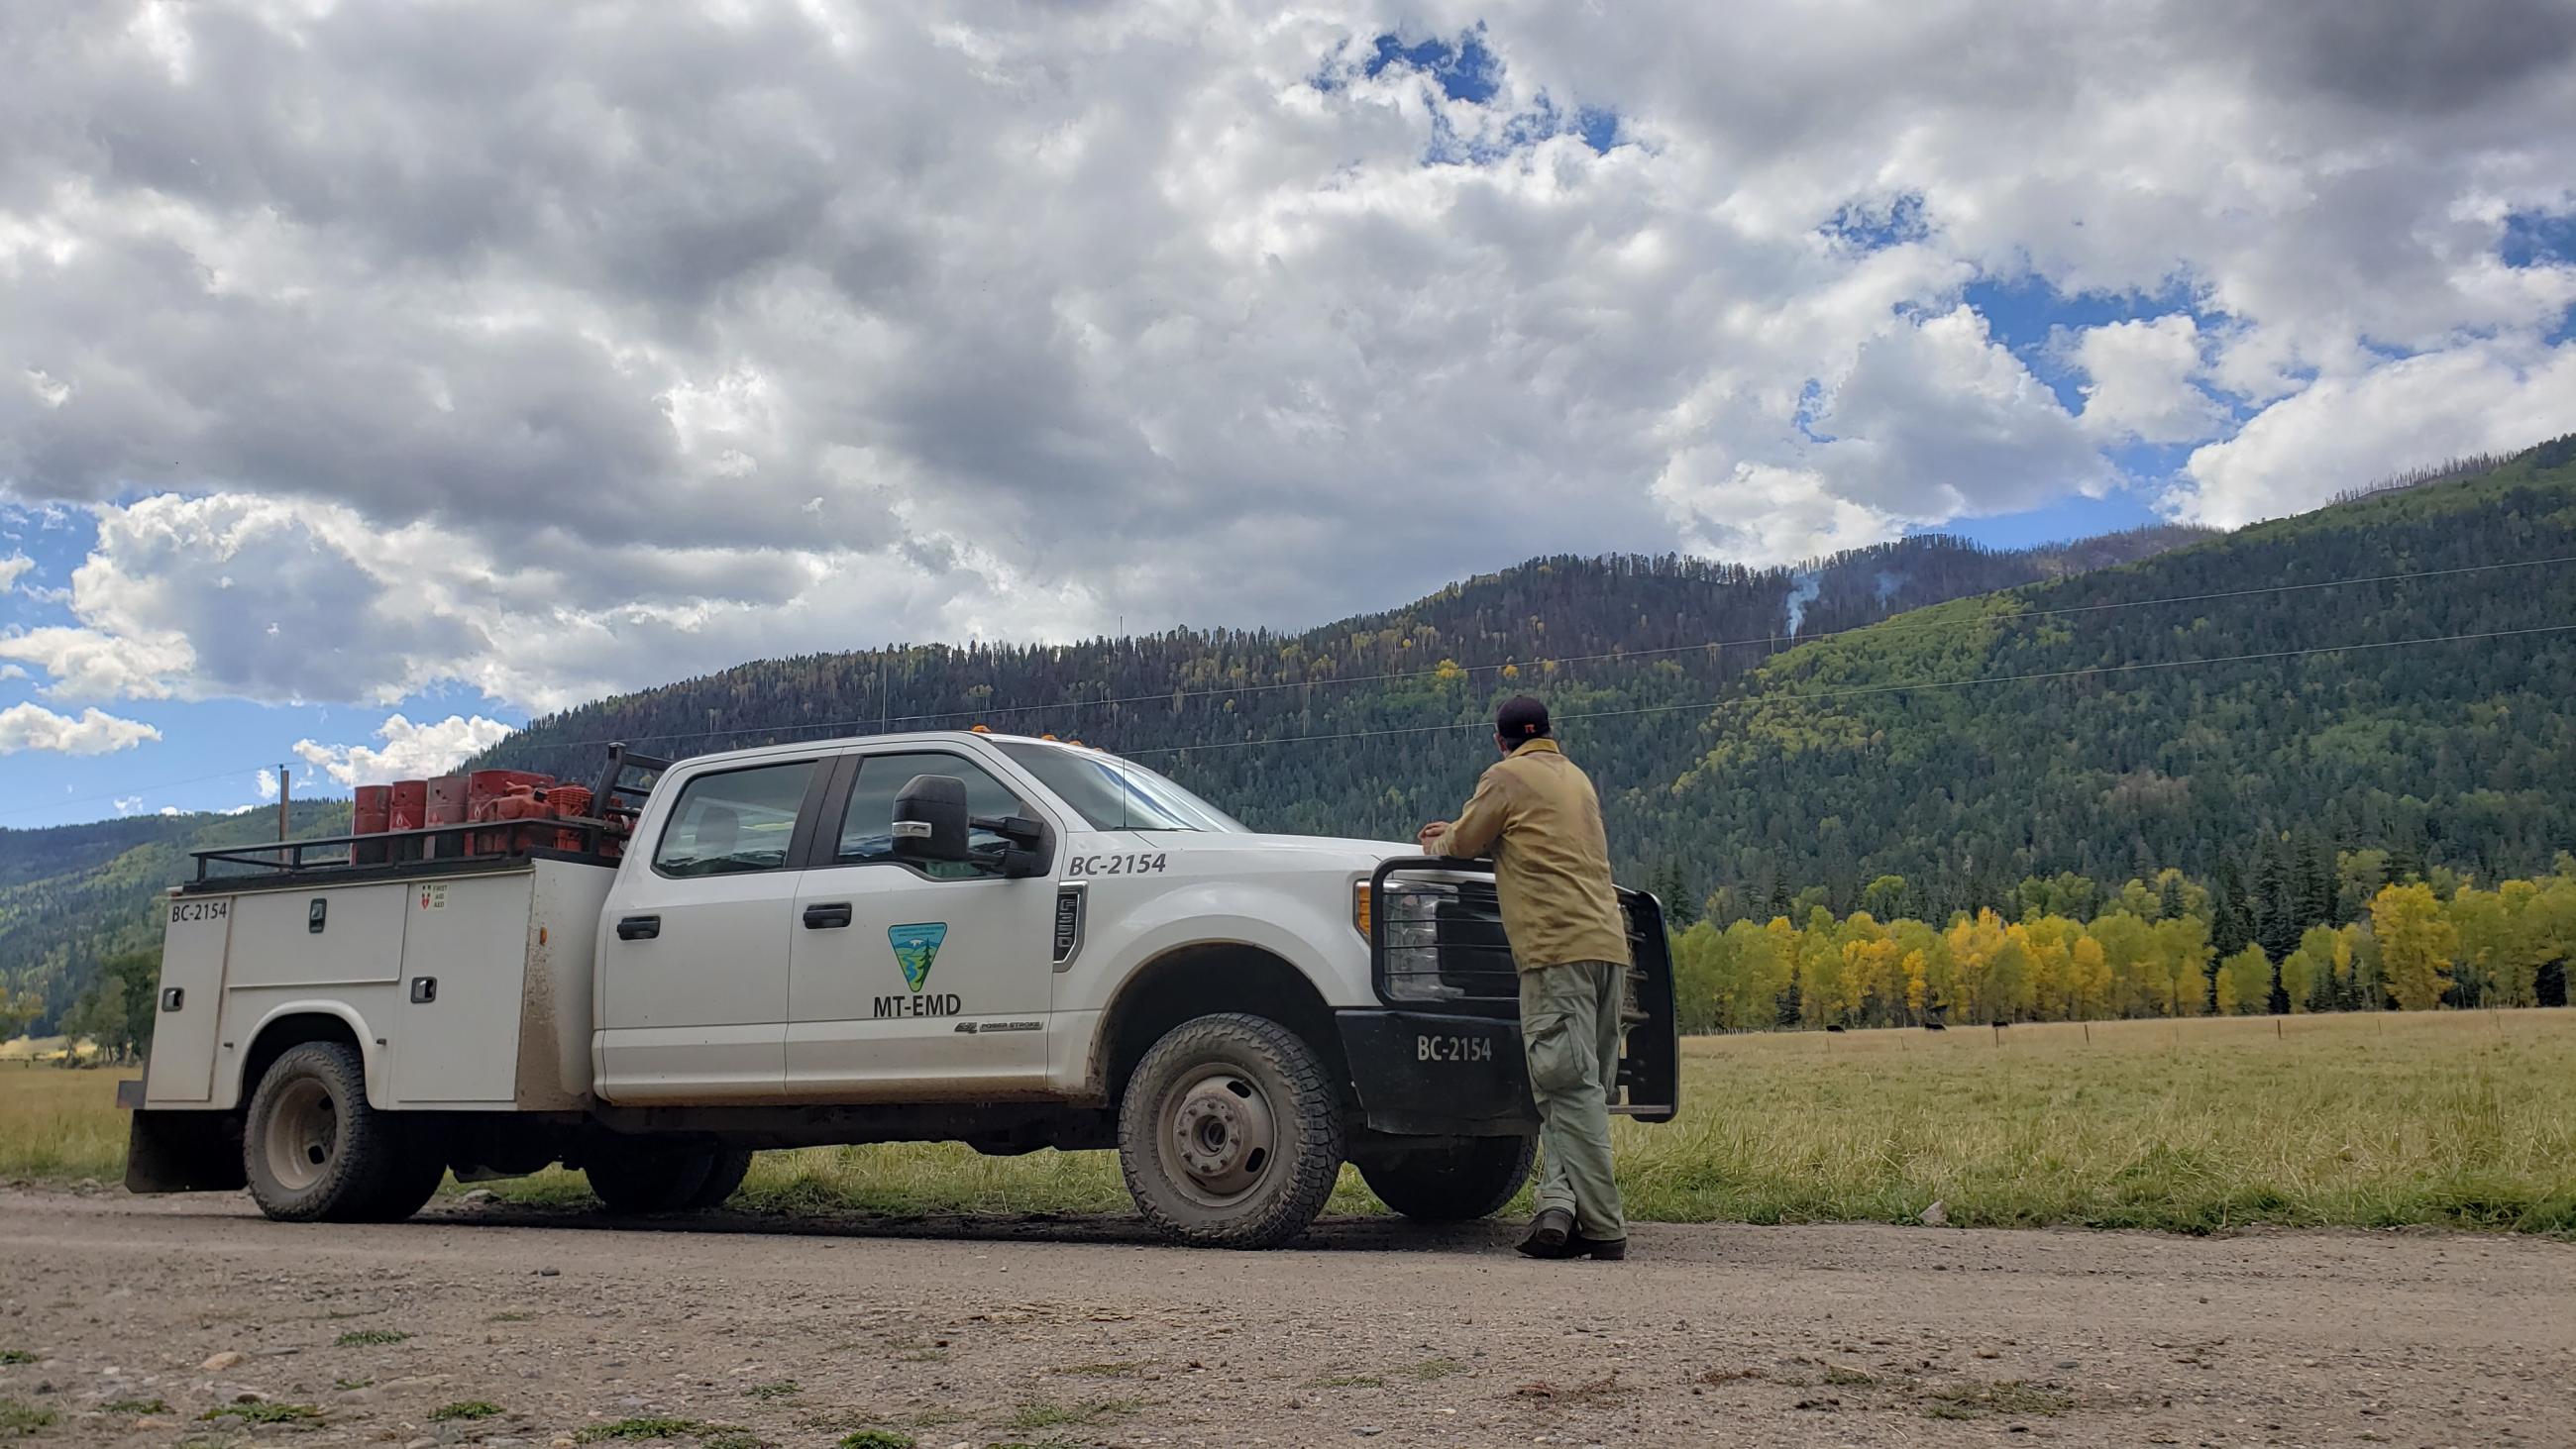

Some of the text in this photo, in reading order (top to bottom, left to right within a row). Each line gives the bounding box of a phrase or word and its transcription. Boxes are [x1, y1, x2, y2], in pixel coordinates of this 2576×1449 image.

[1068, 853, 1166, 877] BC-2154
[172, 902, 227, 923] BC-2154
[873, 993, 961, 1018] MT-EMD
[1418, 1035, 1491, 1062] BC-2154
